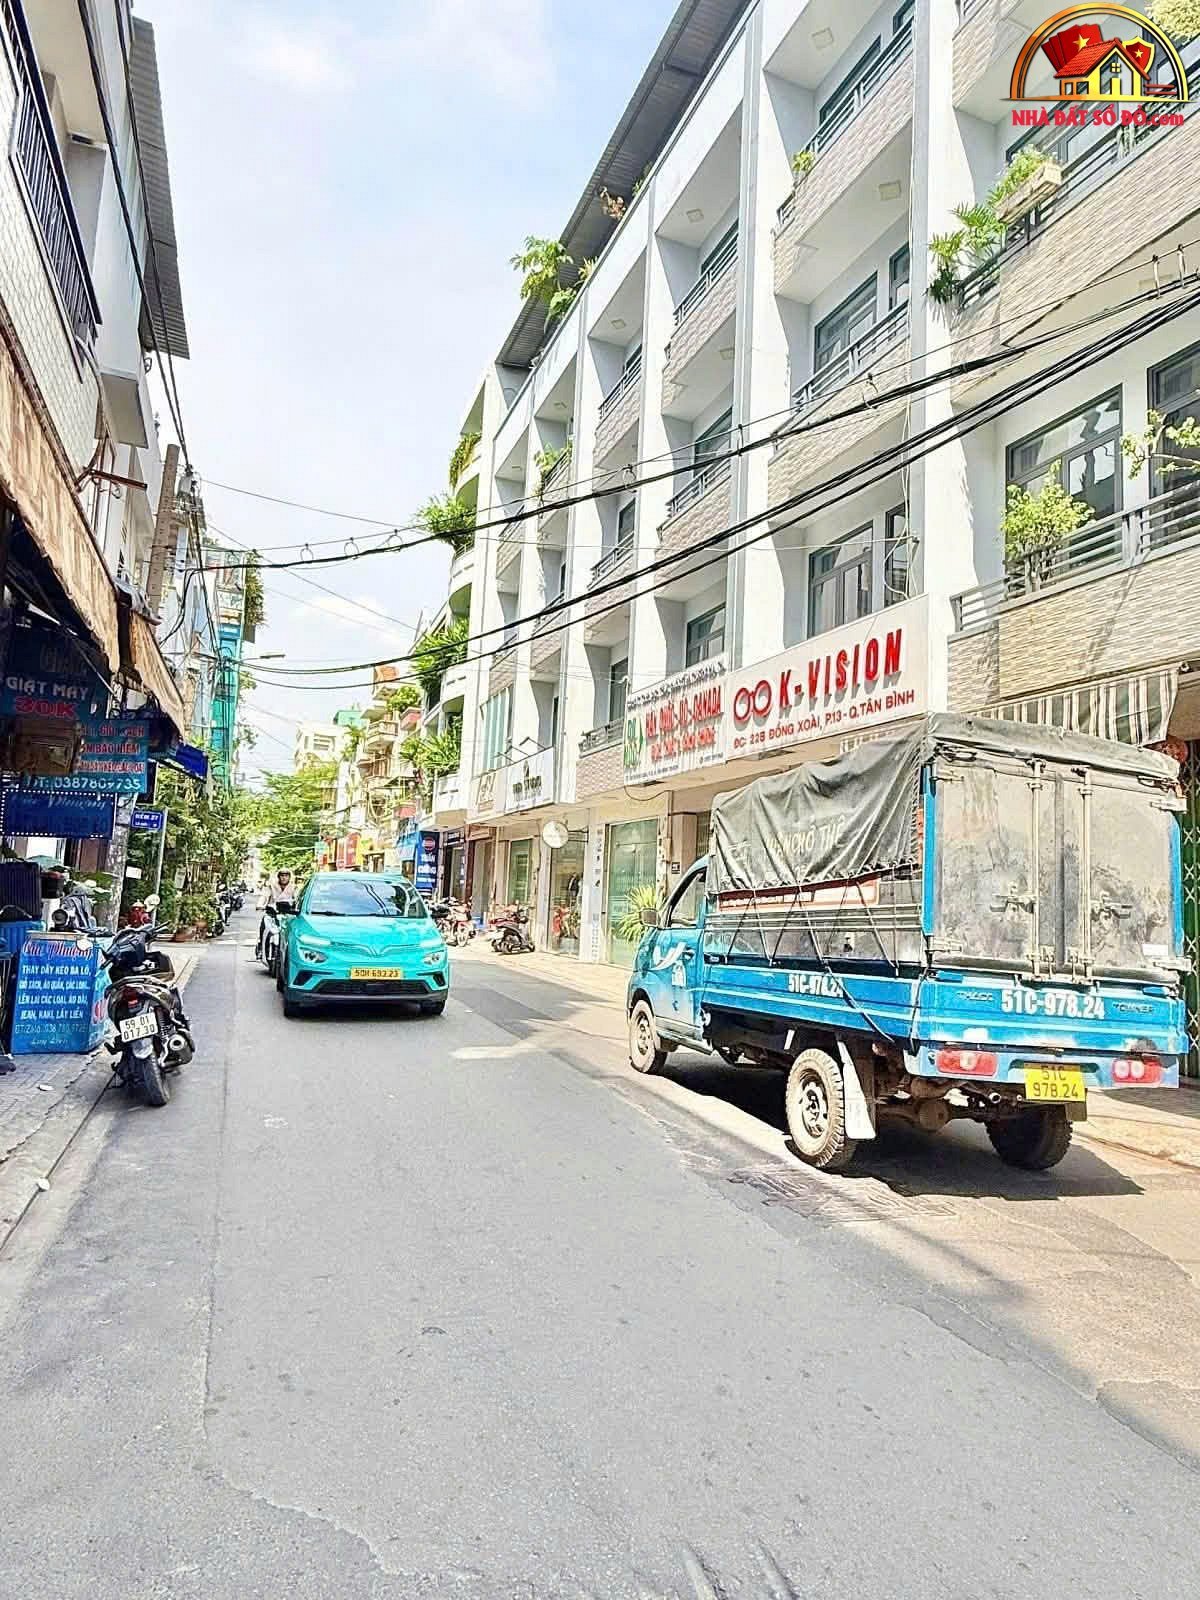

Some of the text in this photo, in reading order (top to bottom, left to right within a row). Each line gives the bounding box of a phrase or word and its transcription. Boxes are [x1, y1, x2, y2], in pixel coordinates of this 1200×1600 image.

[779, 628, 902, 710] K-VISION
[885, 690, 915, 709] BÌNH
[1001, 988, 1105, 1019] 51C-978.24
[1041, 1065, 1066, 1081] 51C
[1033, 1083, 1079, 1100] 978.24
